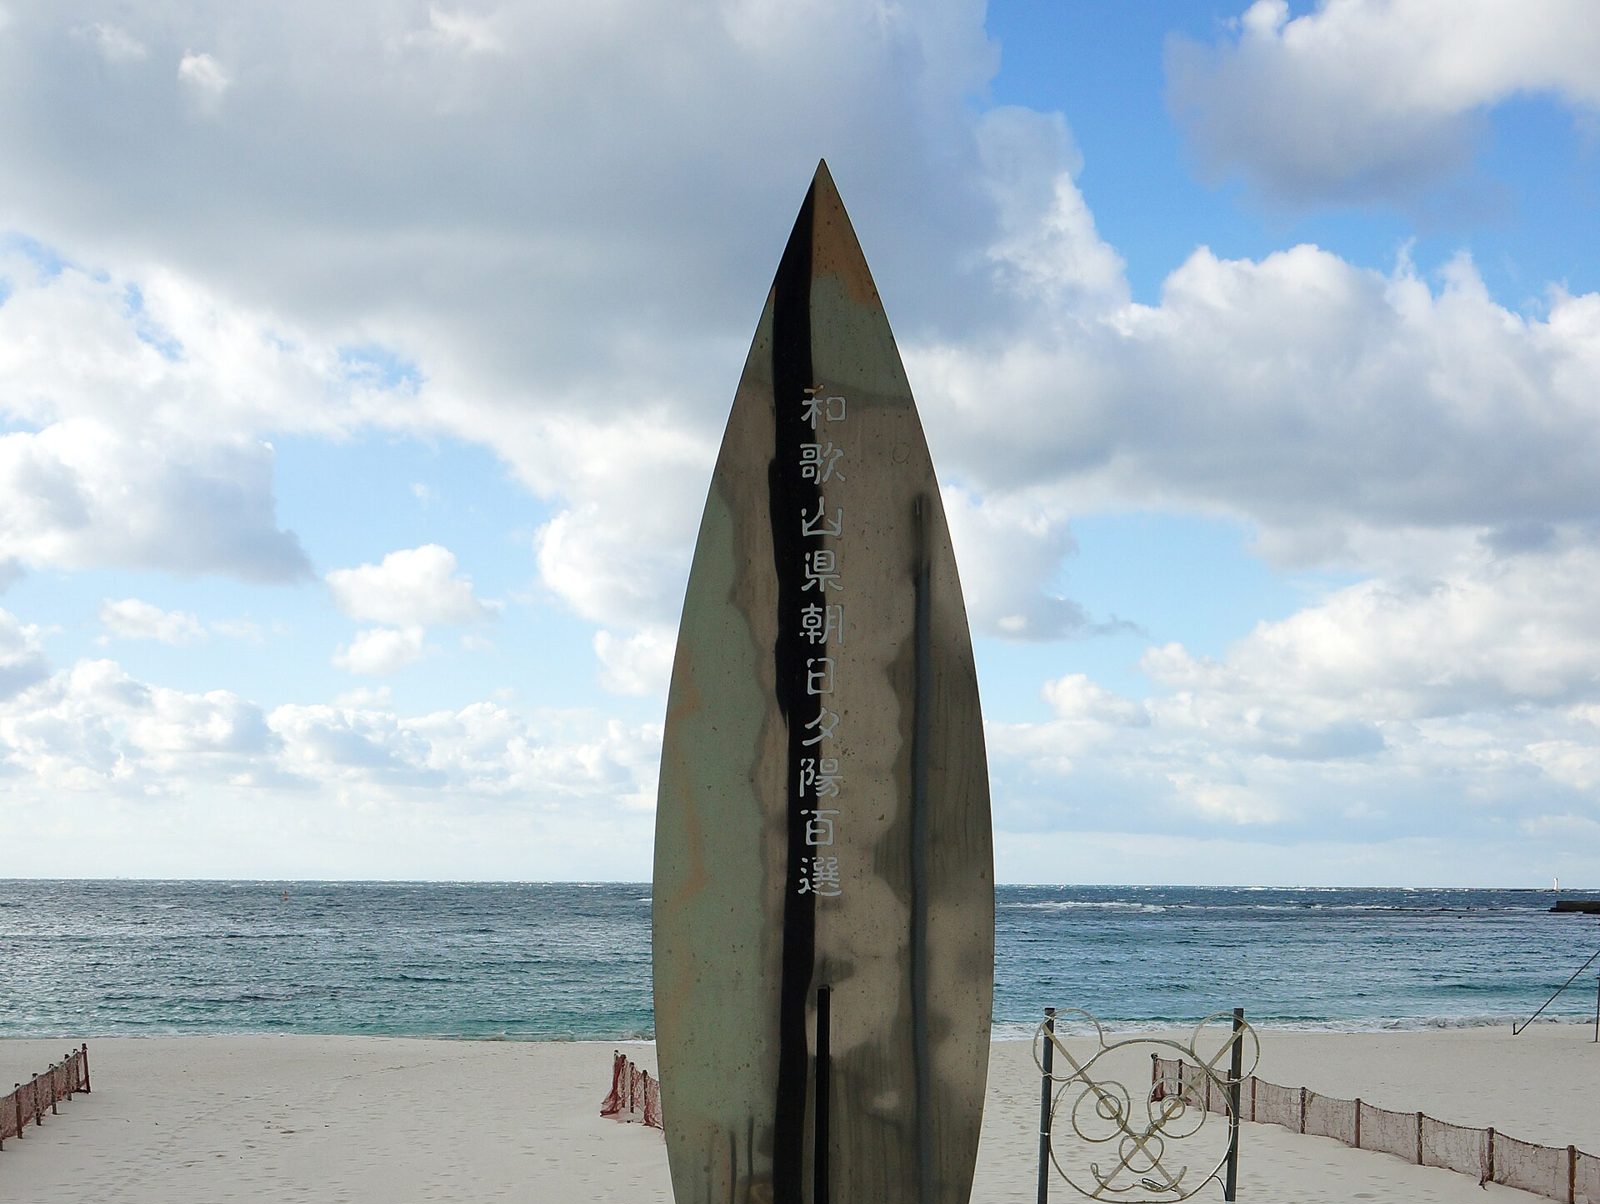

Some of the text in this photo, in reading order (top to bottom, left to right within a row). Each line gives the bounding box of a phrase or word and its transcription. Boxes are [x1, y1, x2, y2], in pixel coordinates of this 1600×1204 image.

[798, 384, 847, 897] 和歌山県朝日夕陽百選
